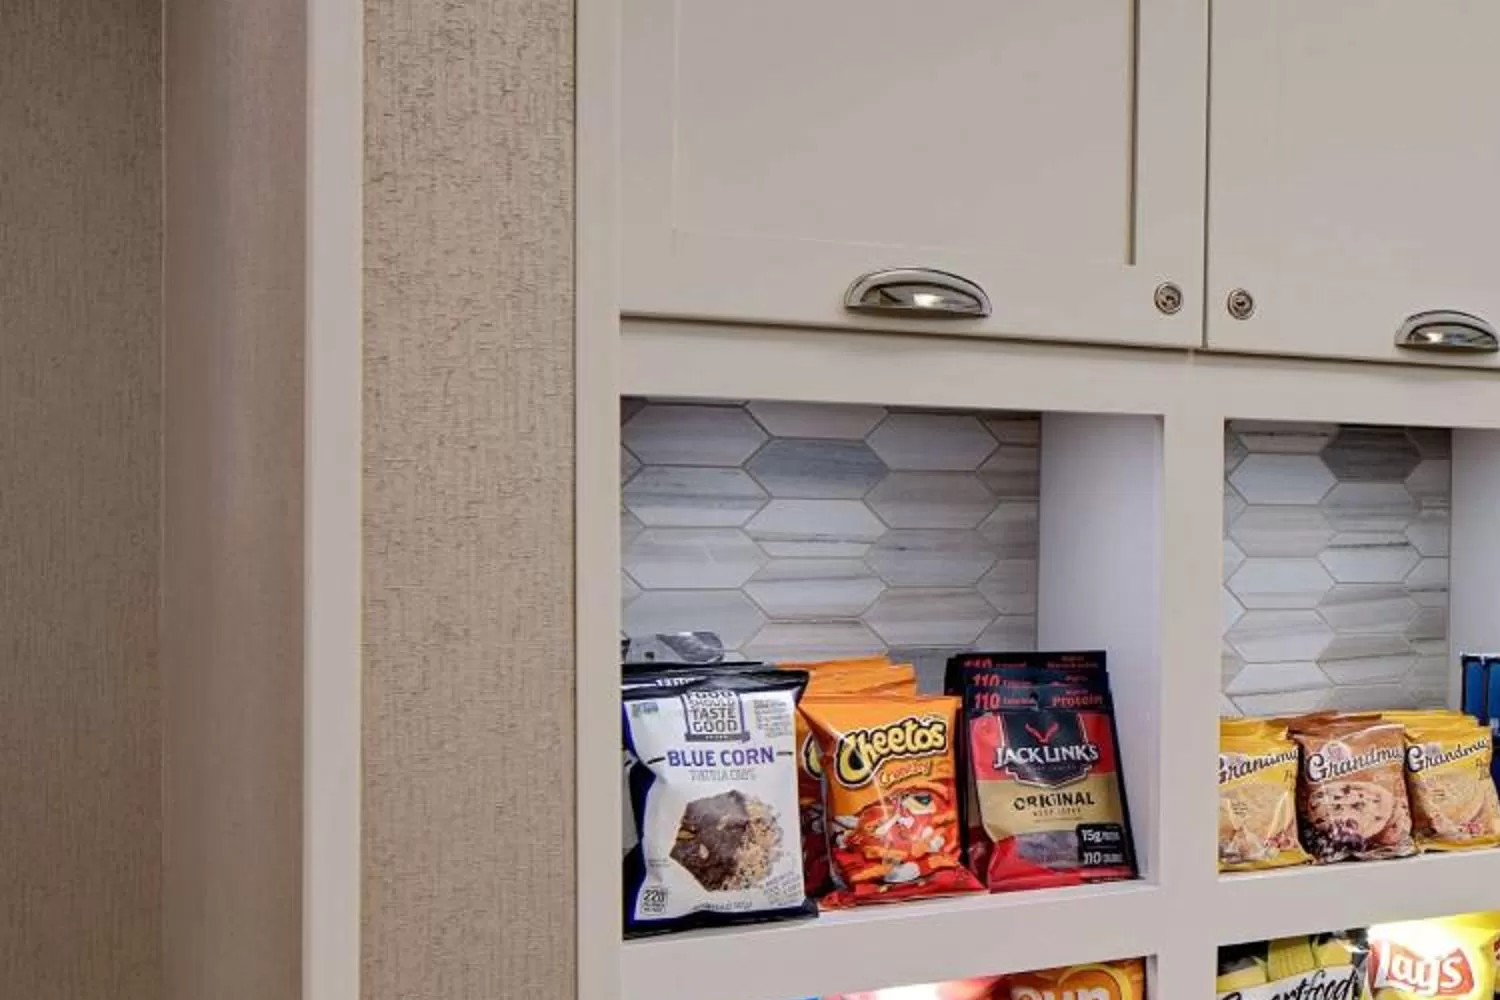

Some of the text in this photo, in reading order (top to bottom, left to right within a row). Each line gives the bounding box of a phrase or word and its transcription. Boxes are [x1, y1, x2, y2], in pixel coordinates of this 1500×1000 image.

[689, 707, 737, 720] TASTE
[693, 719, 738, 733] GOOD
[667, 747, 775, 767] BLUE CORN
[839, 719, 948, 785] Cheetos
[993, 747, 1045, 769] JACK
[1013, 792, 1096, 810] ORIGINAL
